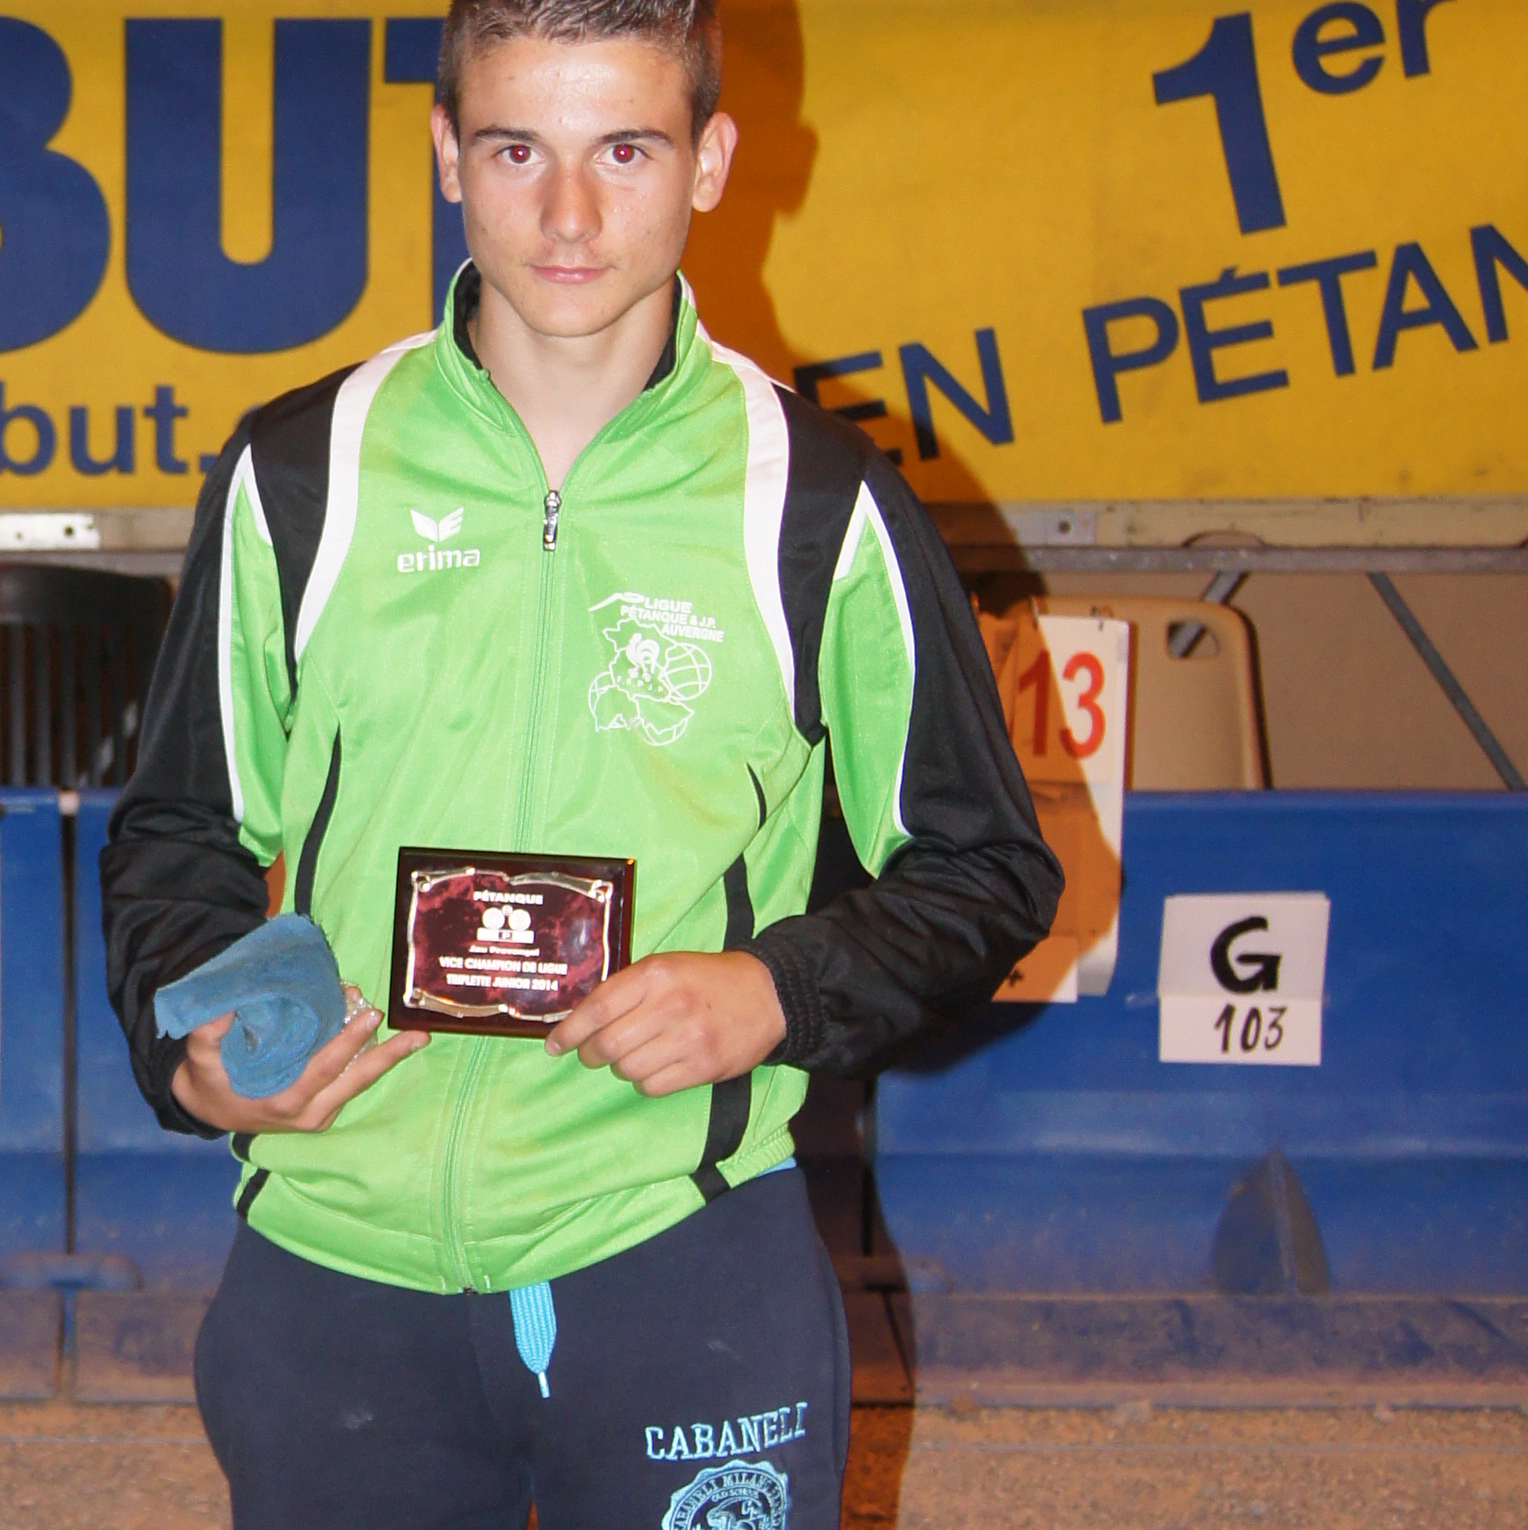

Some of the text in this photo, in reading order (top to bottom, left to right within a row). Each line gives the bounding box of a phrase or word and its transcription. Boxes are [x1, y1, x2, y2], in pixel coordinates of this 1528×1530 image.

[397, 543, 481, 573] erima
[644, 596, 692, 614] LIGUE
[620, 604, 716, 629] PÉTANQUE & J.P.
[662, 623, 724, 643] AUVERGNE
[1018, 650, 1106, 759] 13
[473, 889, 543, 905] PÉTANQUE
[439, 956, 568, 975] VICE CHAMPION DE LIGUE
[1210, 916, 1282, 995] G
[446, 973, 559, 991] TRIPLETTE JUNIOR 2014
[1214, 1003, 1285, 1054] 103
